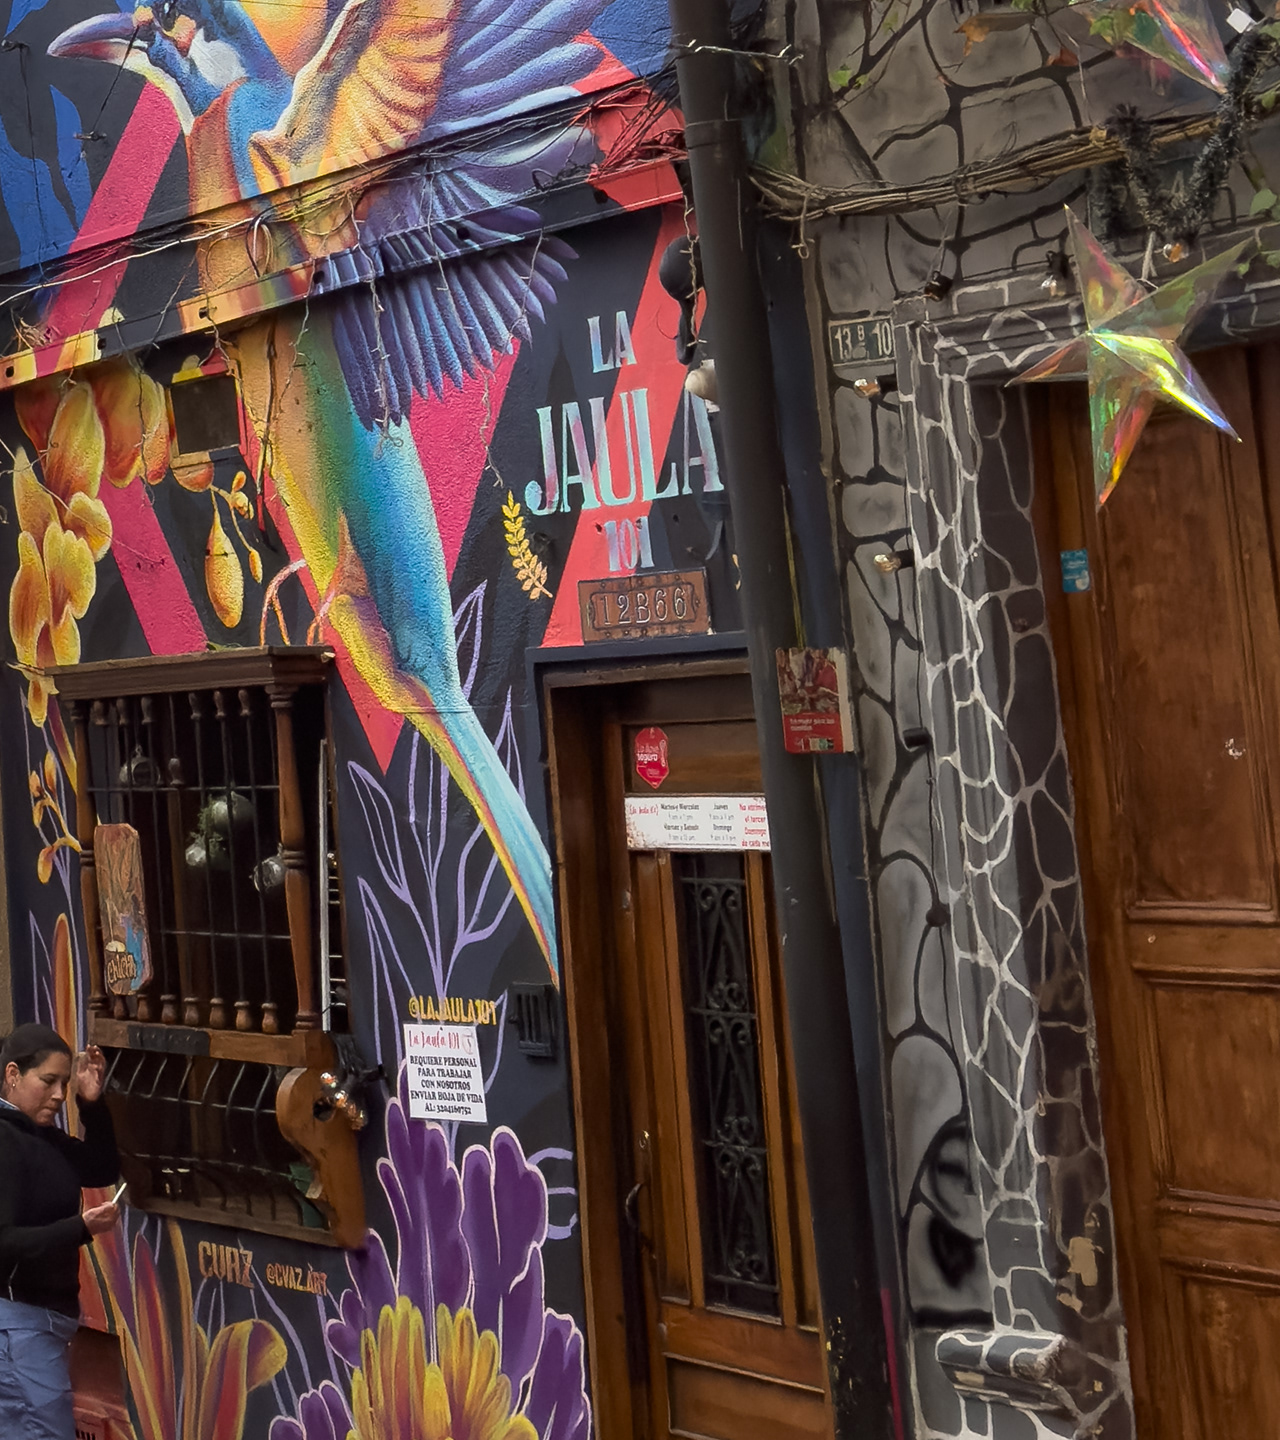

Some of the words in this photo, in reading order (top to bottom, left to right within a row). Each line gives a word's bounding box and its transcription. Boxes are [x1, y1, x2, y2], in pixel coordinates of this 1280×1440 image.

[587, 310, 637, 374] LA
[525, 387, 725, 516] JAULA
[604, 515, 655, 573] 101
[600, 586, 689, 627] 12B66
[410, 1055, 443, 1067] REQUIERE
[443, 1056, 478, 1068] PERSONAL
[417, 1067, 436, 1077] PARA
[437, 1068, 473, 1079] TRABAJAR
[410, 1090, 437, 1100] ENVIAR
[437, 1091, 456, 1102] HOJA
[466, 1093, 484, 1104] VIDA
[420, 1079, 436, 1089] CON
[436, 1080, 471, 1091] NOSOTROS
